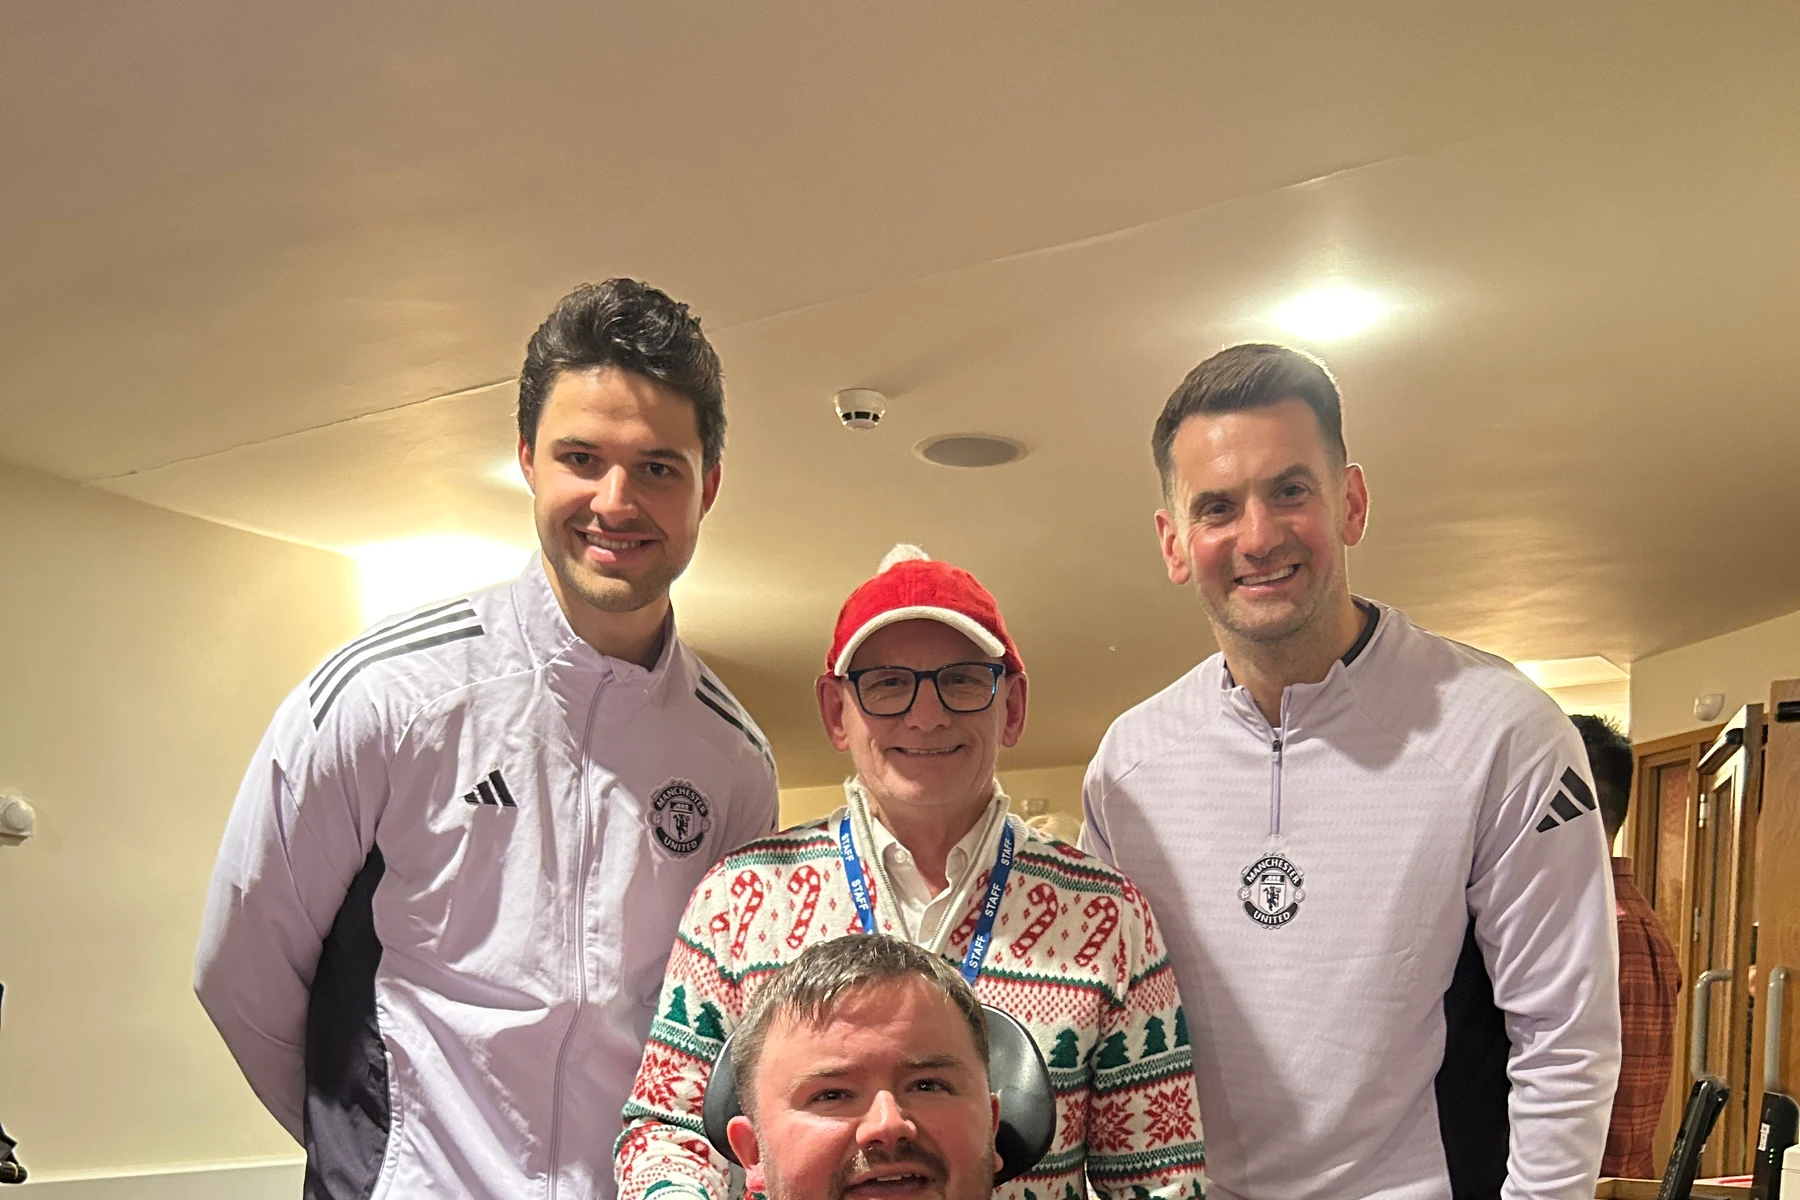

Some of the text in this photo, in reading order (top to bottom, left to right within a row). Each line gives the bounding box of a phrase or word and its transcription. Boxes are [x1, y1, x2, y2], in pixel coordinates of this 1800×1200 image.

[656, 787, 708, 814] MANCHESTER
[664, 837, 698, 852] UNITED
[841, 833, 869, 911] STAFF STAFF
[1246, 858, 1301, 884] MANCHESTER
[968, 837, 1013, 969] STAFF STAFF STAFF
[1253, 910, 1290, 924] UNITED
